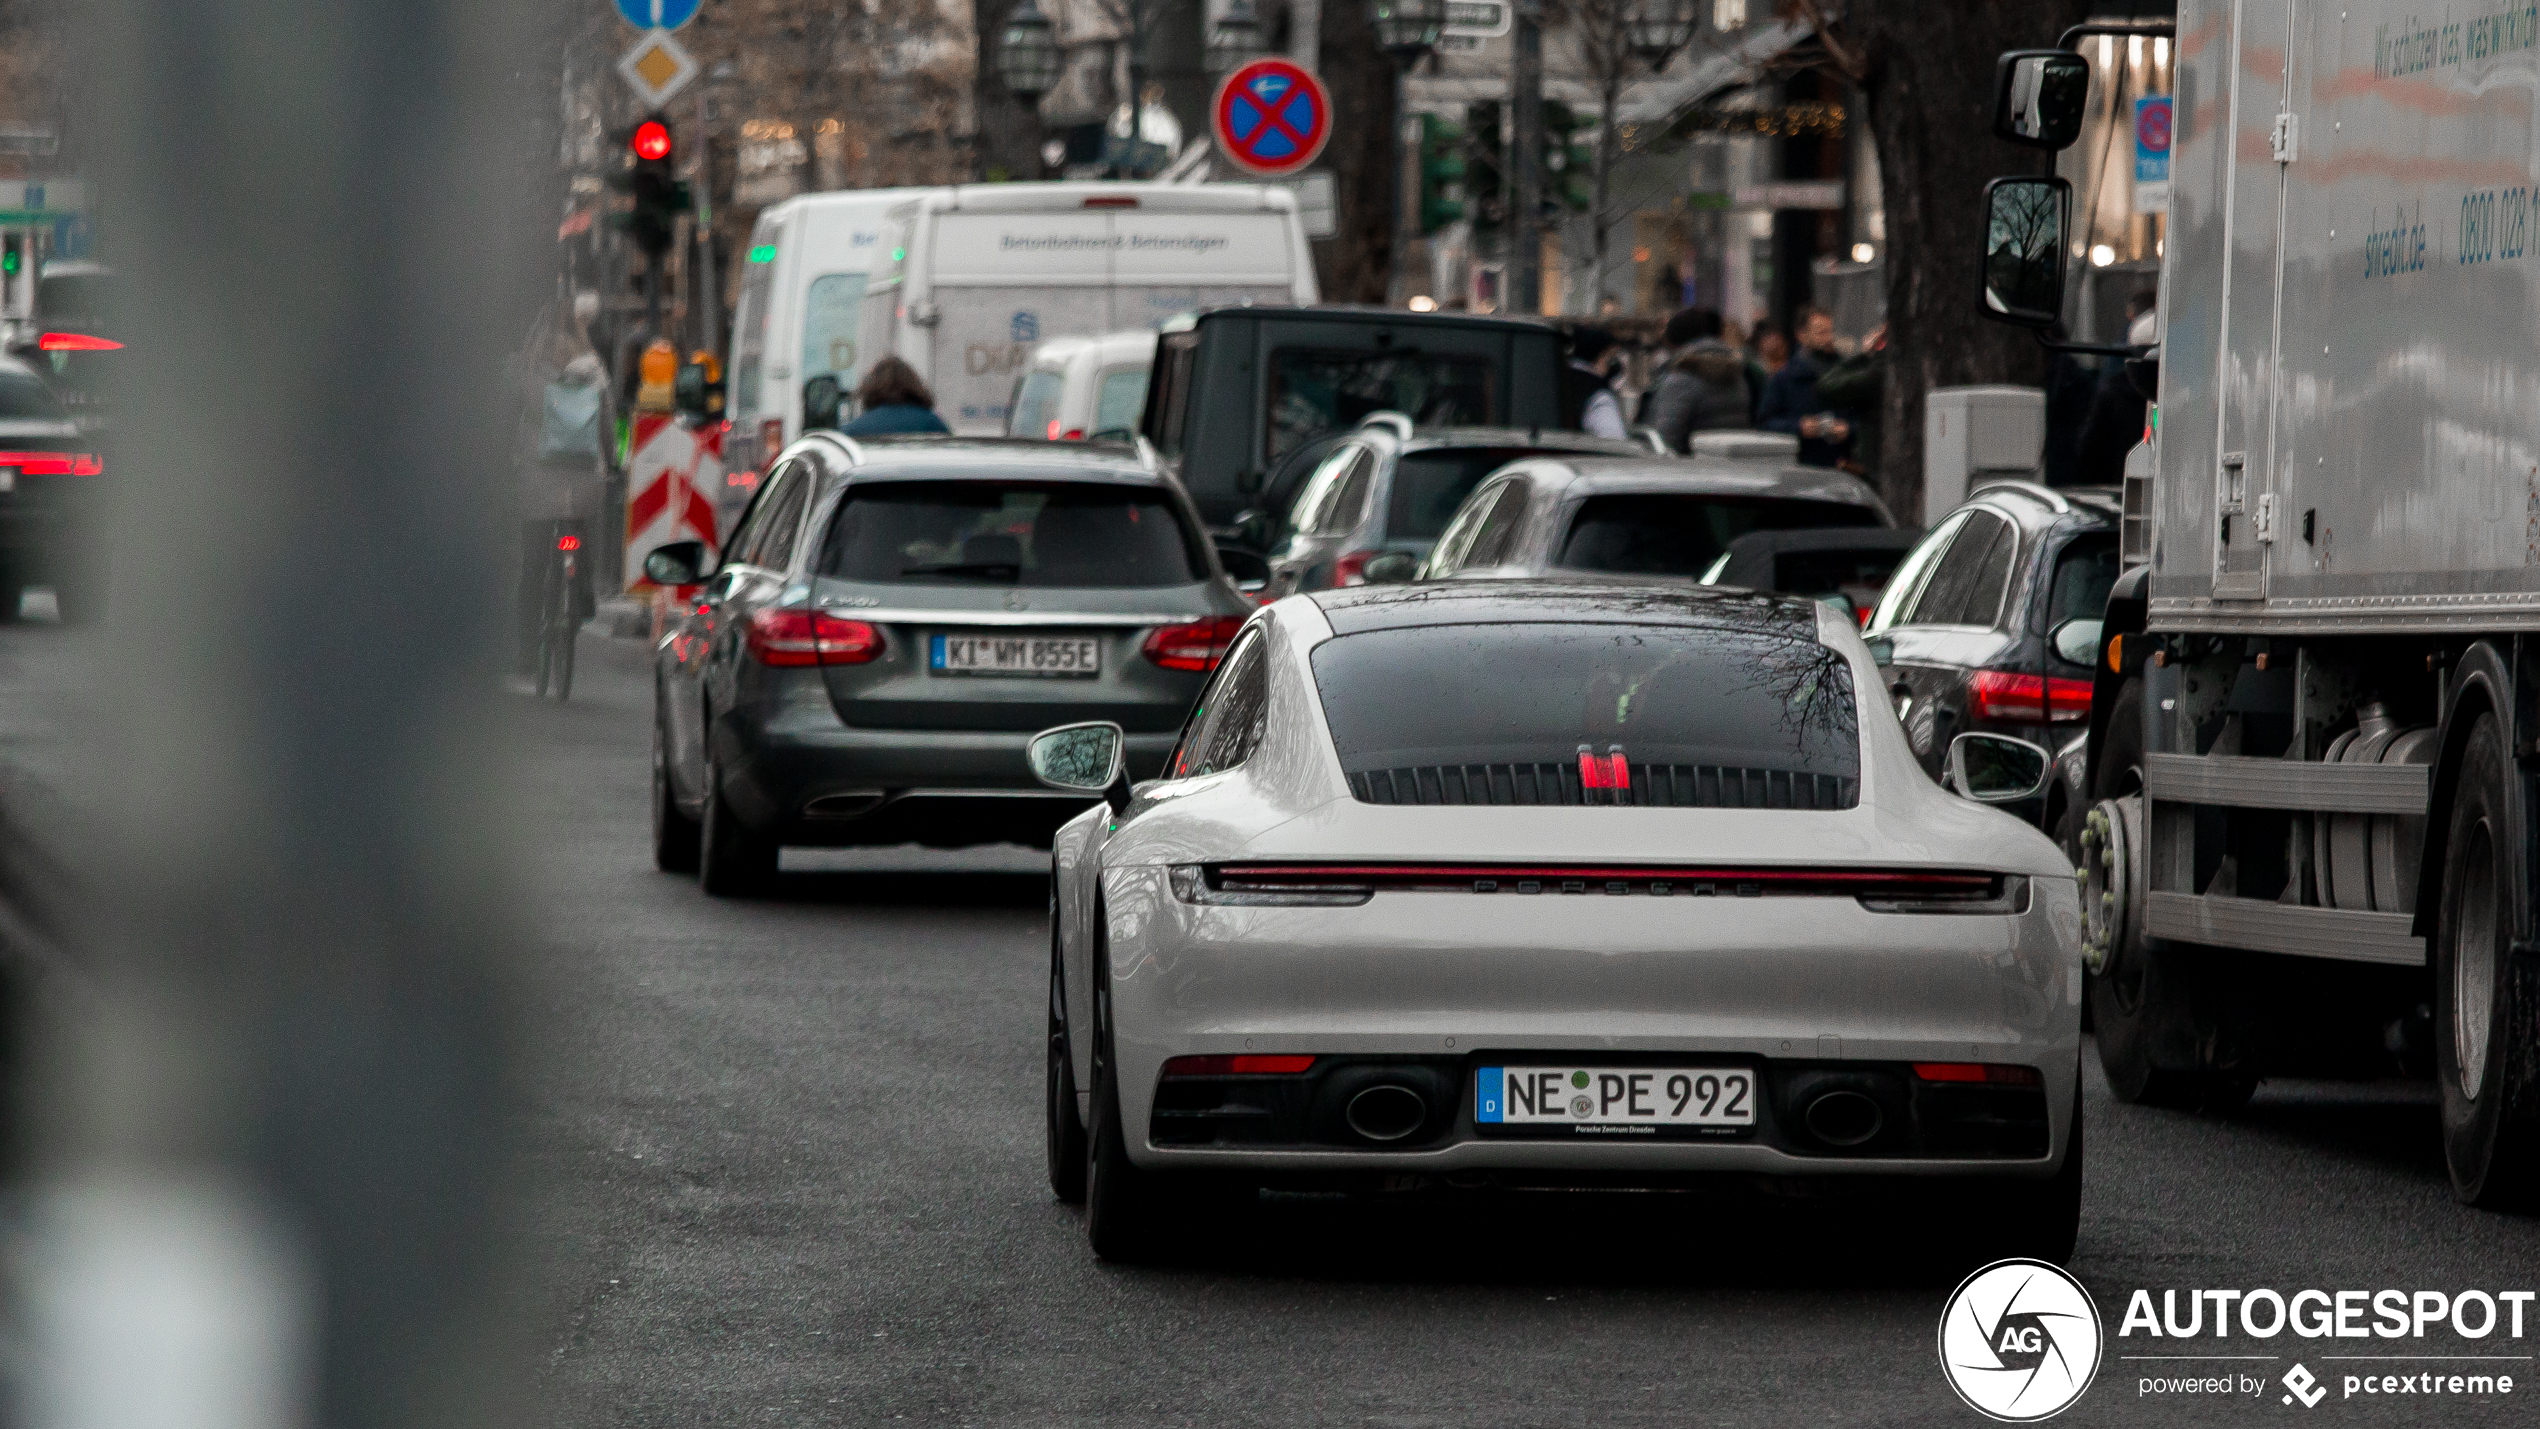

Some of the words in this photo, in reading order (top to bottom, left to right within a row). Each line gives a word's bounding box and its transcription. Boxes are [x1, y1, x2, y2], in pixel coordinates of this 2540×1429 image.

[2374, 21, 2391, 81] Wir
[2393, 14, 2438, 78] schützen
[2440, 3, 2462, 72] das,
[2466, 15, 2489, 60] was
[2459, 190, 2495, 266] 0800
[2499, 186, 2527, 260] 028
[949, 640, 976, 667] KI
[1033, 641, 1094, 669] 855E
[1473, 879, 1761, 897] PORSCHE
[1485, 1099, 1496, 1113] D
[1507, 1072, 1566, 1116] NE
[1598, 1073, 1655, 1117] PE
[1666, 1074, 1750, 1118] 992
[1575, 1124, 1601, 1134] Porsche
[1602, 1124, 1628, 1134] Zentrum
[1629, 1125, 1656, 1134] Dresden
